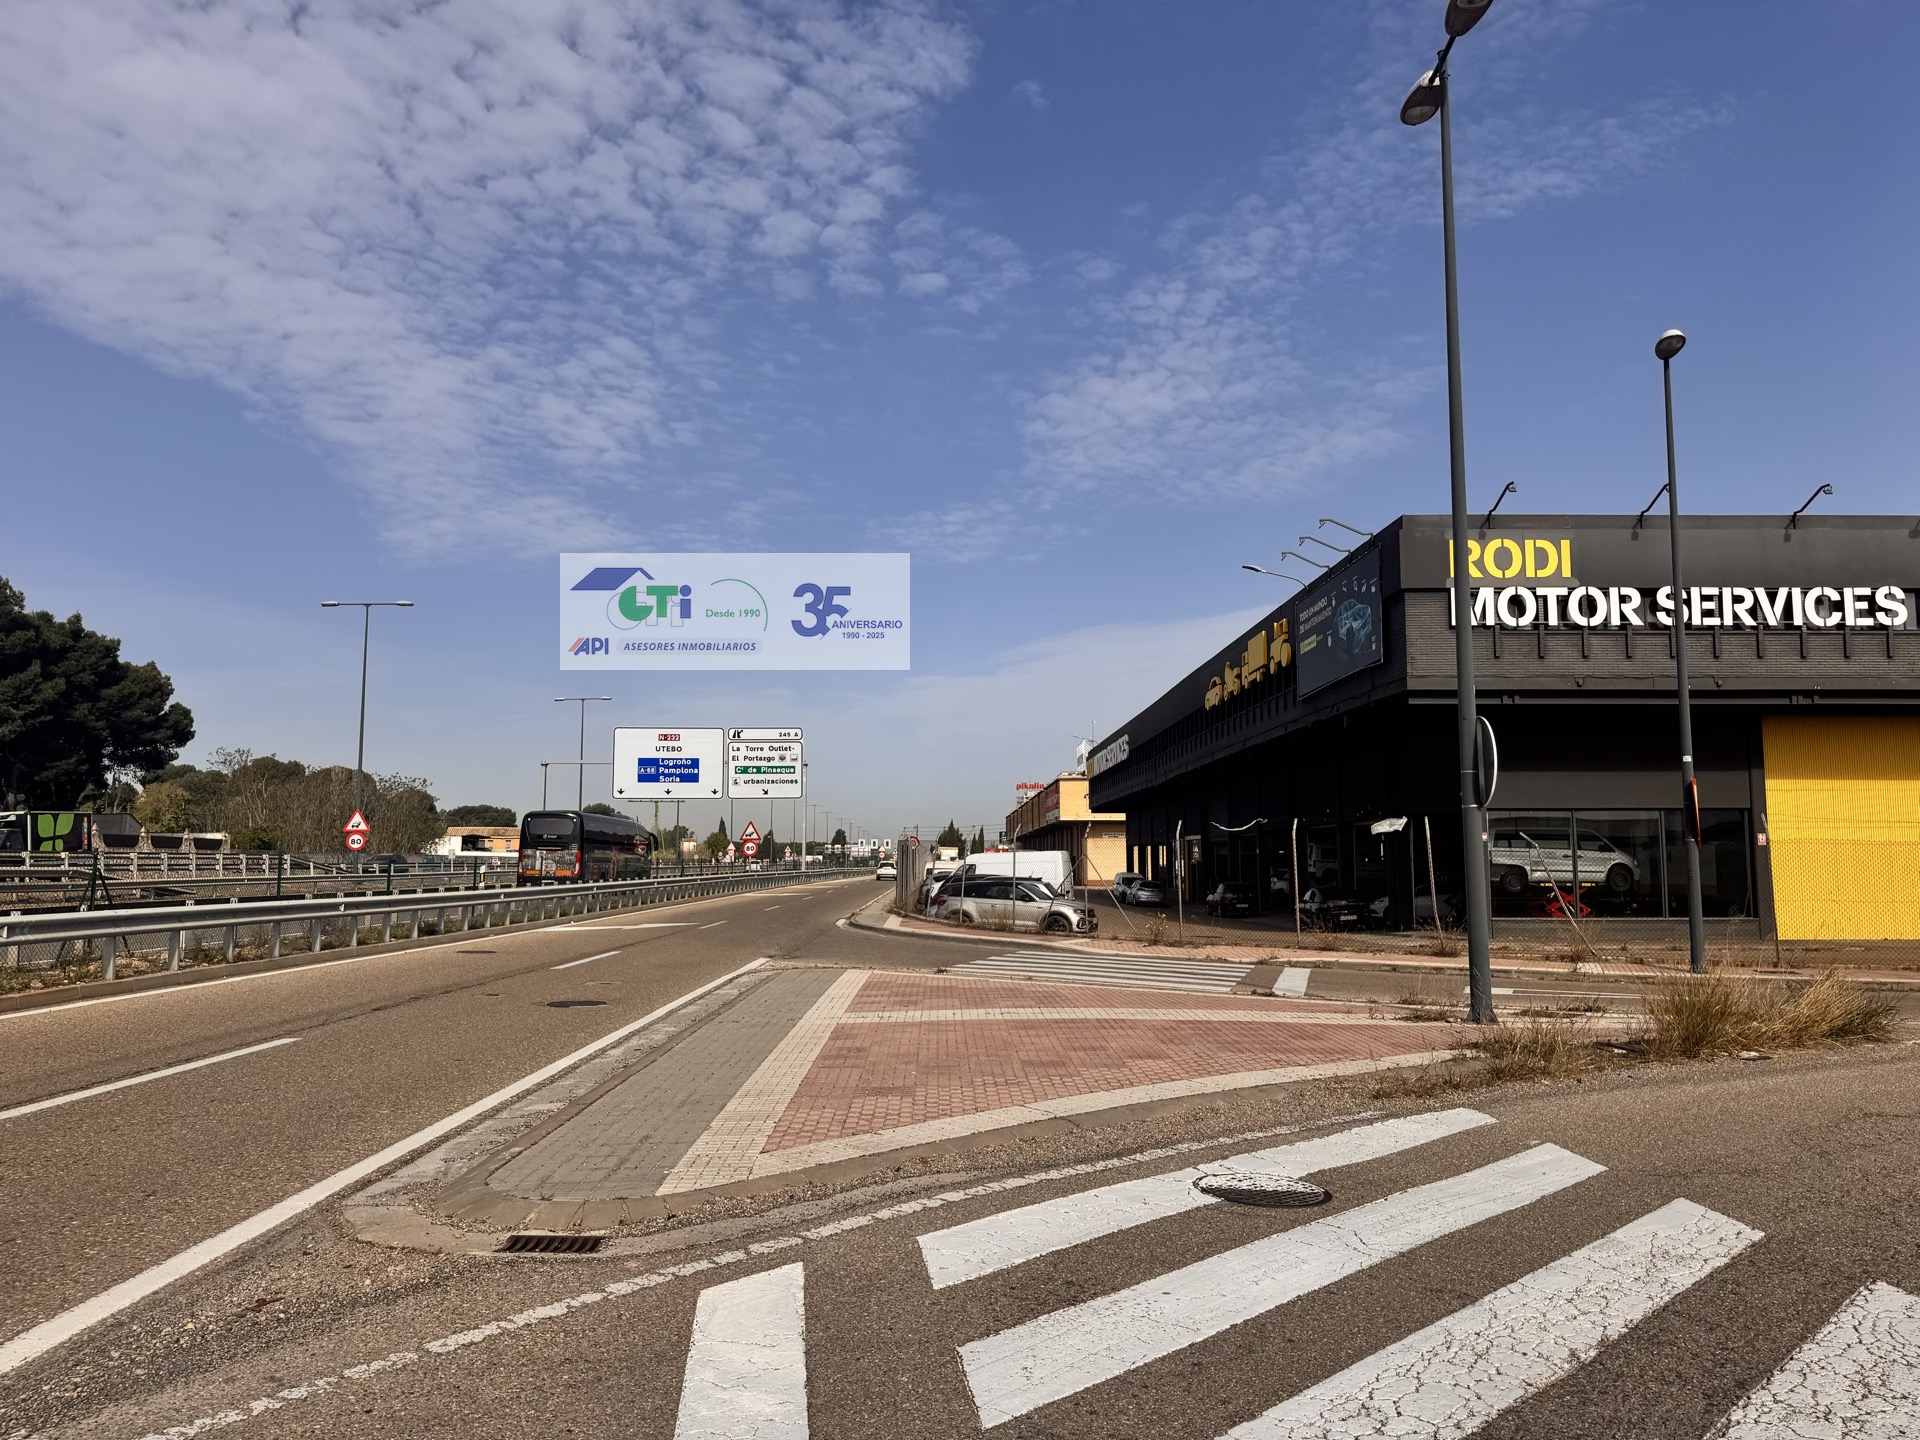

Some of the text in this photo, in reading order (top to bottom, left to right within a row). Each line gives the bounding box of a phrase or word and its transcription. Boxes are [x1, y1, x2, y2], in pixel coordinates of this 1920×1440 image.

[1449, 538, 1572, 579] RODI
[1451, 585, 1908, 627] MOTOR SERVICES
[655, 745, 683, 753] UTEBO
[659, 758, 692, 766] Logroño
[743, 755, 776, 763] Portazgo
[760, 766, 795, 774] Pinseque
